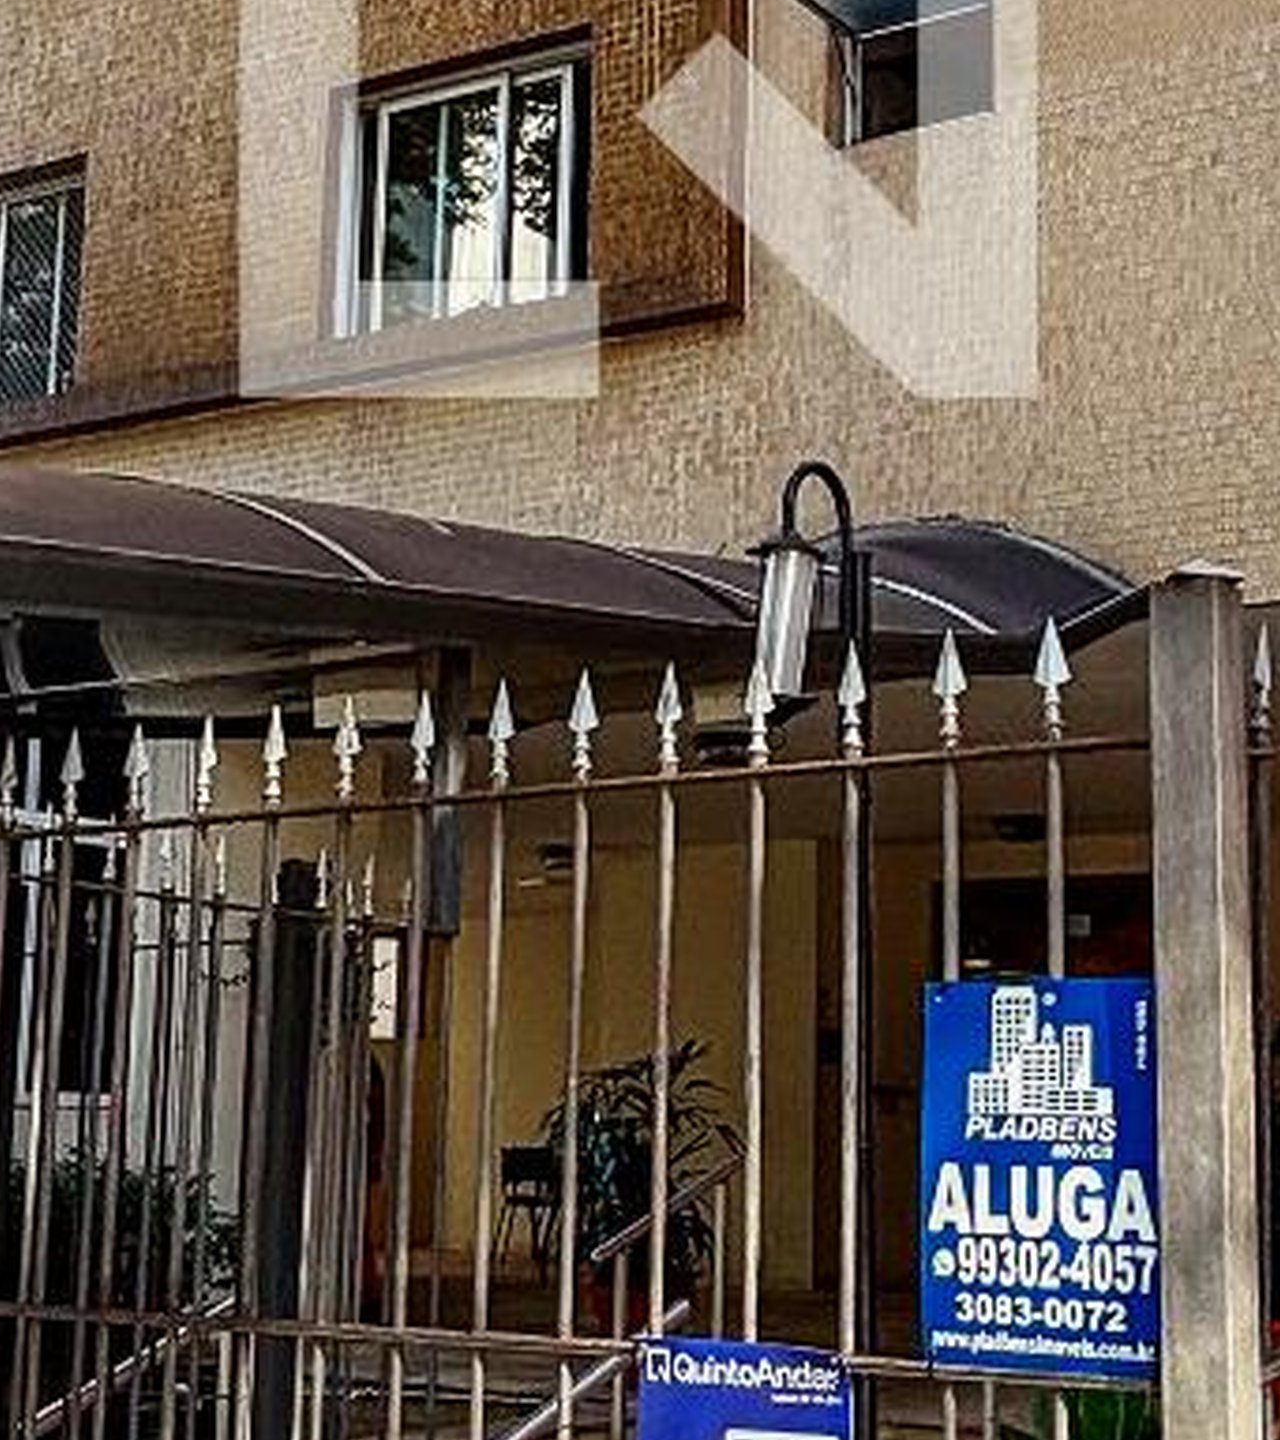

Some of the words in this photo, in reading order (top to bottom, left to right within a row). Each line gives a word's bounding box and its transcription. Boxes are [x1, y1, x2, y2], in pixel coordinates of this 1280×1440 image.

[965, 1117, 1118, 1142] PLADBENS
[928, 1162, 1158, 1242] ALUGA
[957, 1236, 1158, 1295] 99302-4057
[955, 1292, 1128, 1333] 3083-0072
[673, 1353, 839, 1391] QuintoAndar
